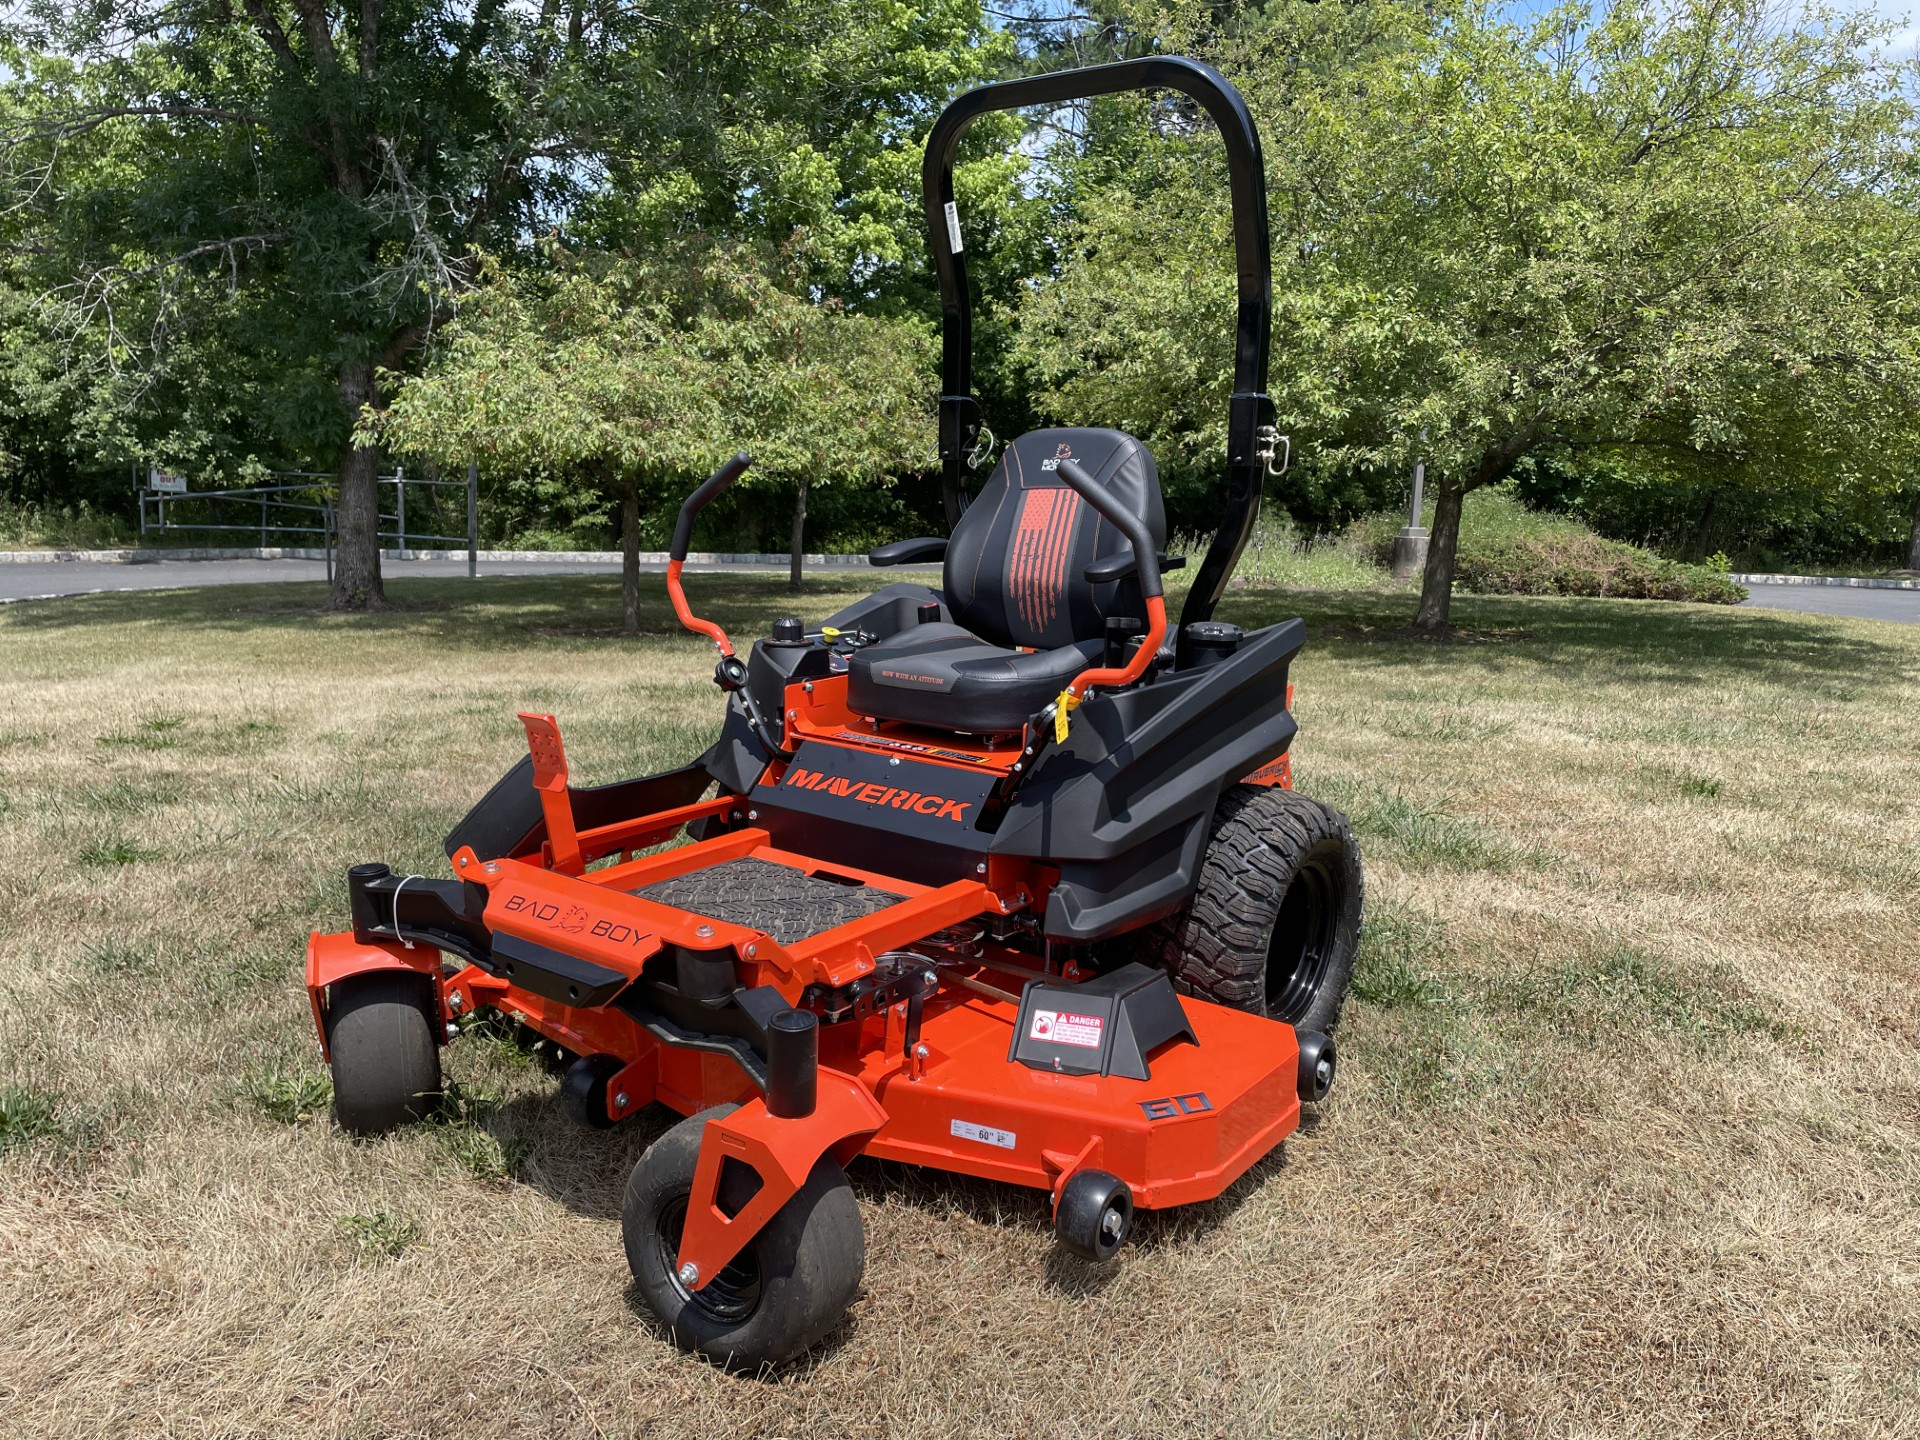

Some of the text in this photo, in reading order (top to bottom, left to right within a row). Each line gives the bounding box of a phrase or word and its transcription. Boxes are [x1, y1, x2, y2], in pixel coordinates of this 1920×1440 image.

[895, 672, 909, 680] WITH
[909, 674, 918, 682] AN
[918, 675, 945, 685] ATTITUDE
[786, 768, 973, 822] MAVERICK
[504, 895, 652, 946] BAD BOY
[1069, 1015, 1101, 1027] DANGER
[1136, 1091, 1215, 1121] 60
